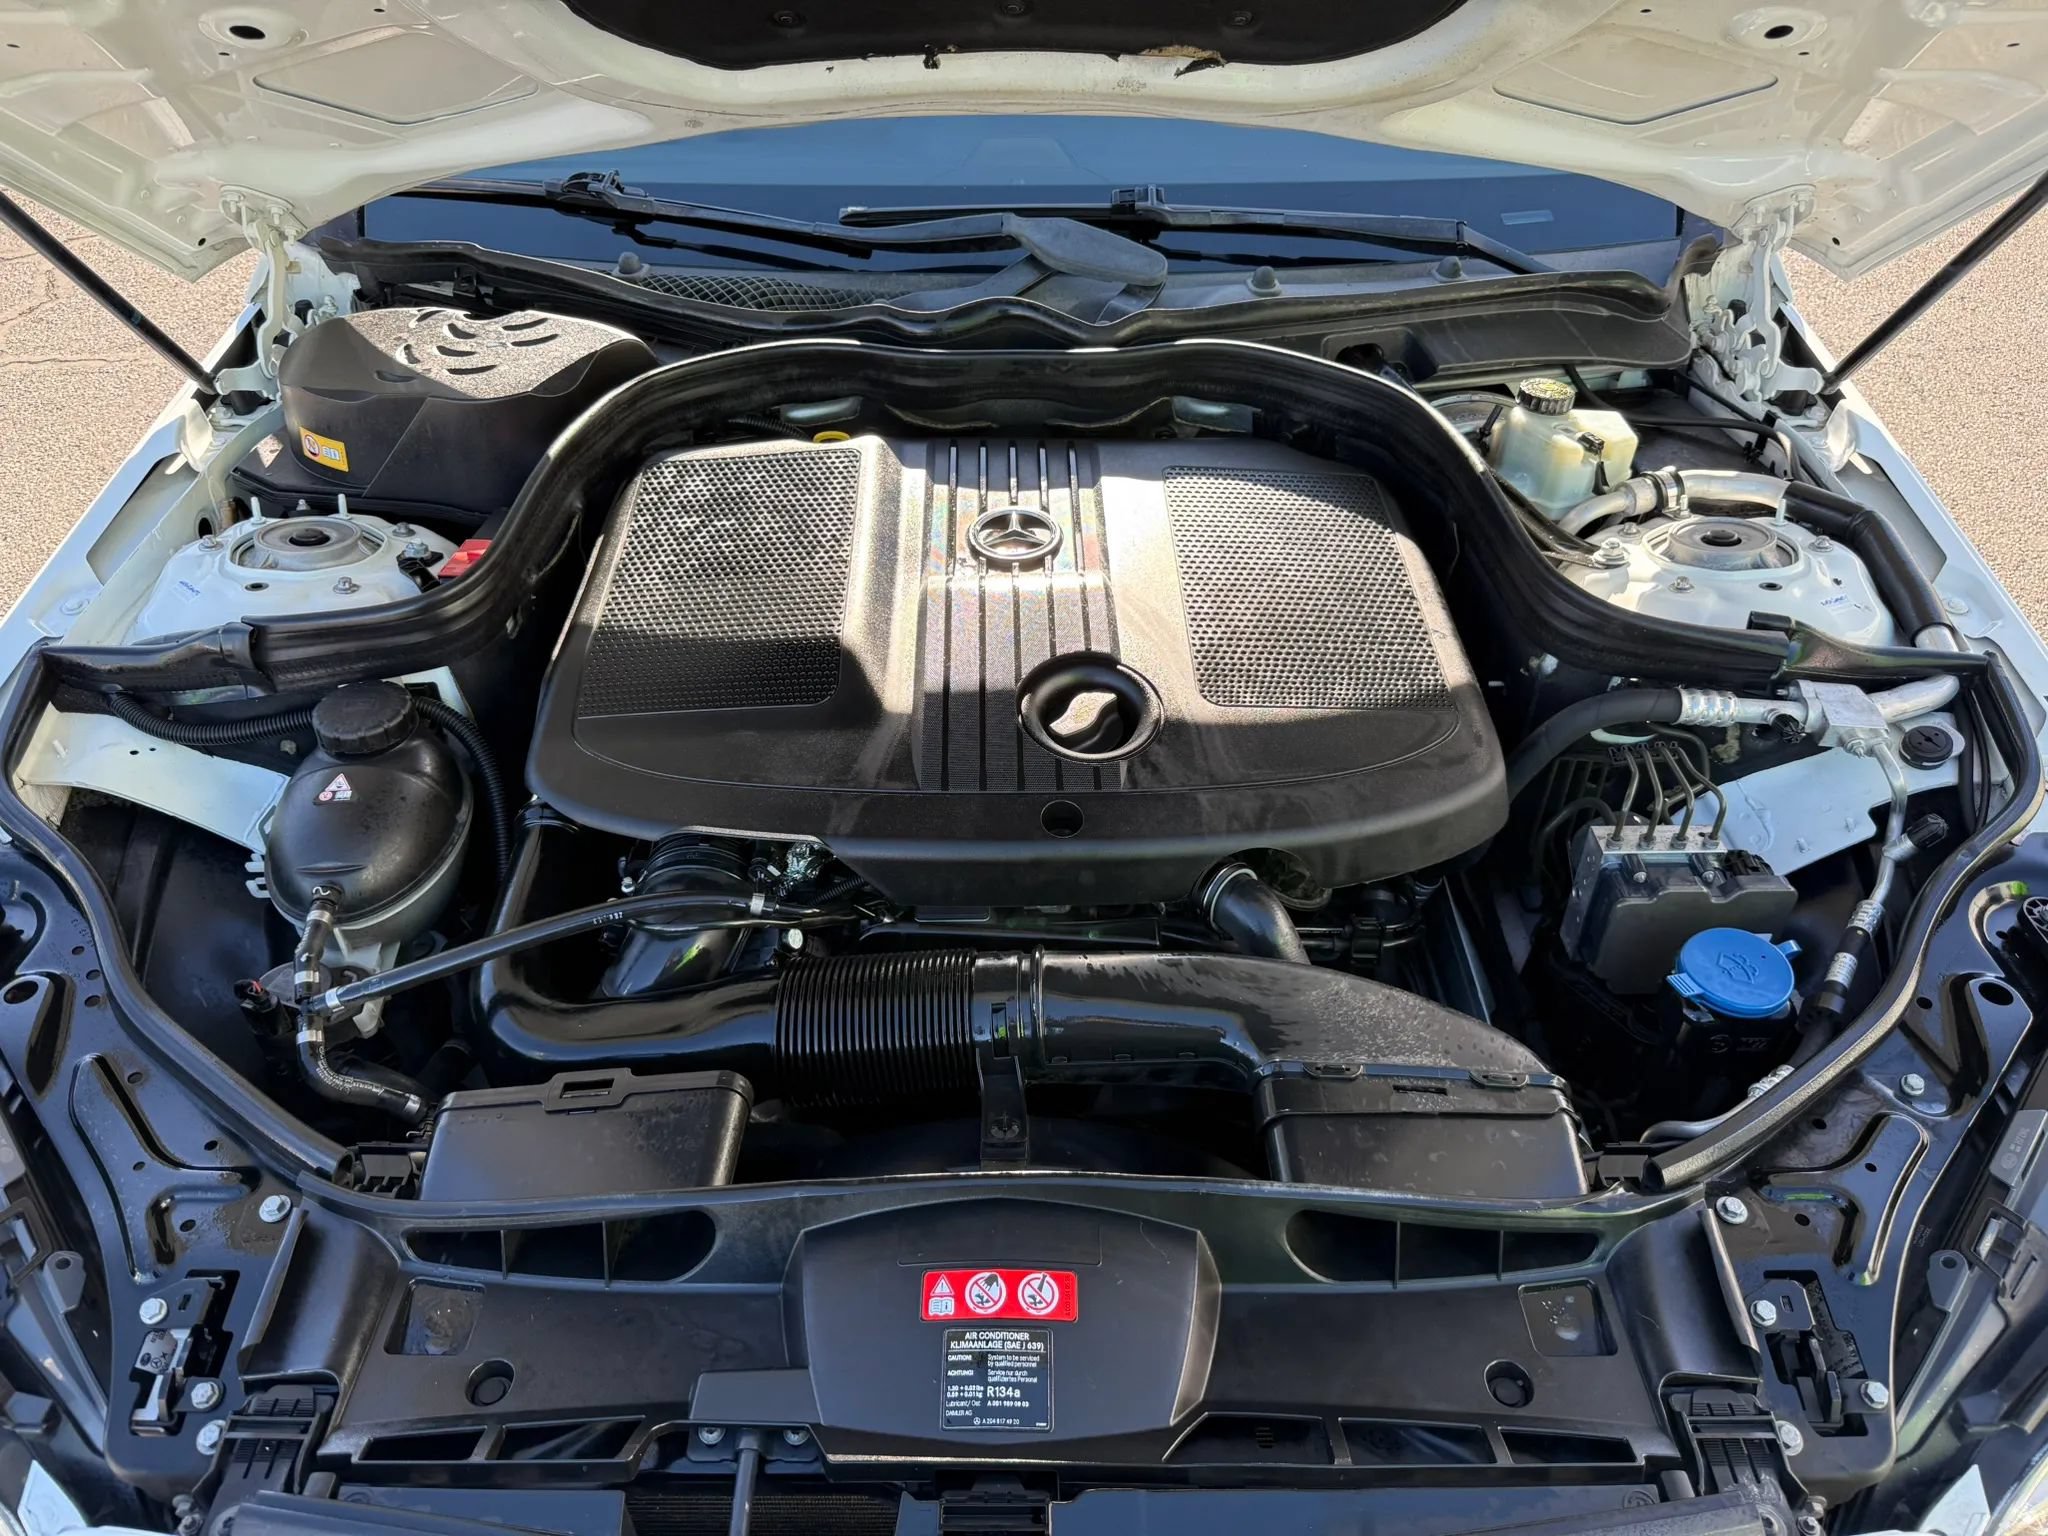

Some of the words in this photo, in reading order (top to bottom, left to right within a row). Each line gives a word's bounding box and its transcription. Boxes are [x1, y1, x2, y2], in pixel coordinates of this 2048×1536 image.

[979, 1332, 1029, 1340] CONDITIONER
[950, 1341, 1002, 1349] KLIMAANLAGE
[1004, 1341, 1020, 1350] (SAE
[1027, 1342, 1044, 1352] 639)
[987, 1386, 1020, 1397] R134a
